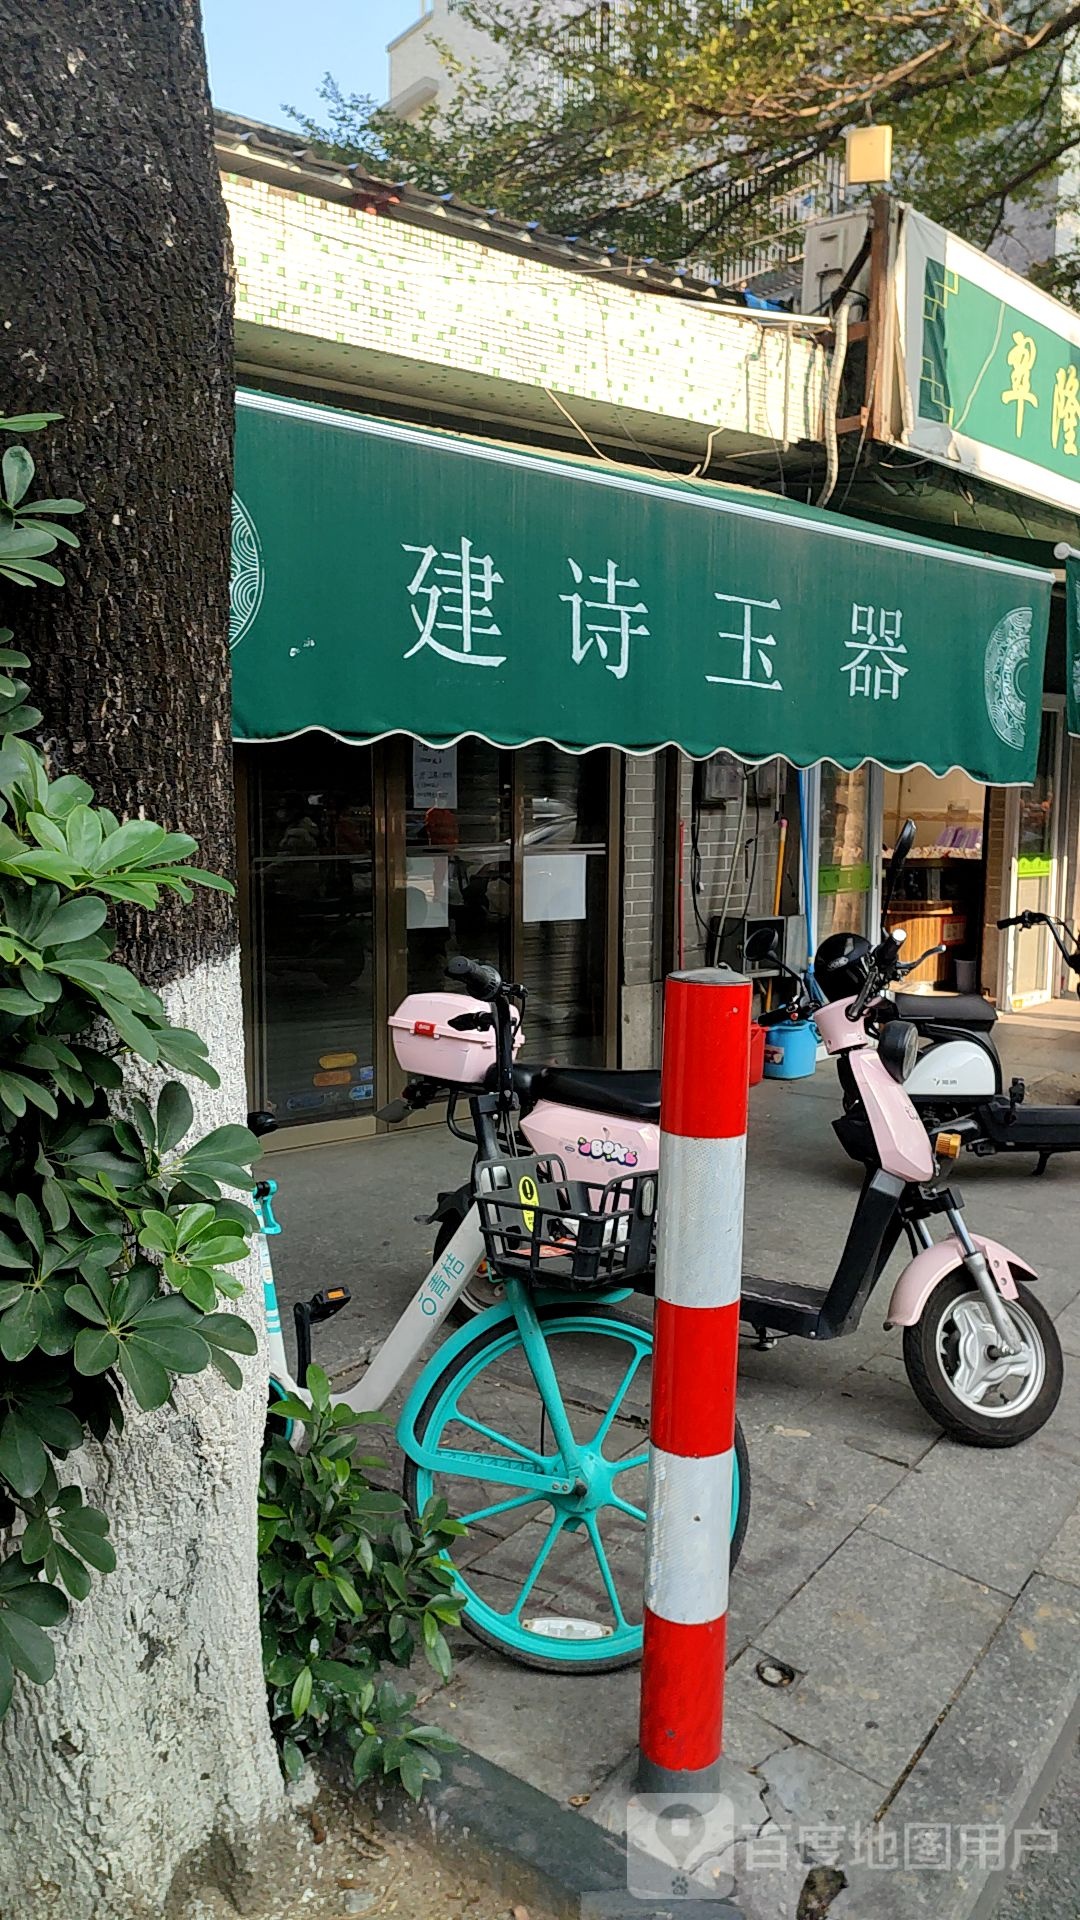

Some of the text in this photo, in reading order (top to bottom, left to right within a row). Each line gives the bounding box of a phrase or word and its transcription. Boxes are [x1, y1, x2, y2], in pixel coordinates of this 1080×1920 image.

[401, 536, 909, 700] 建诗玉器
[427, 1252, 465, 1300] 青桔
